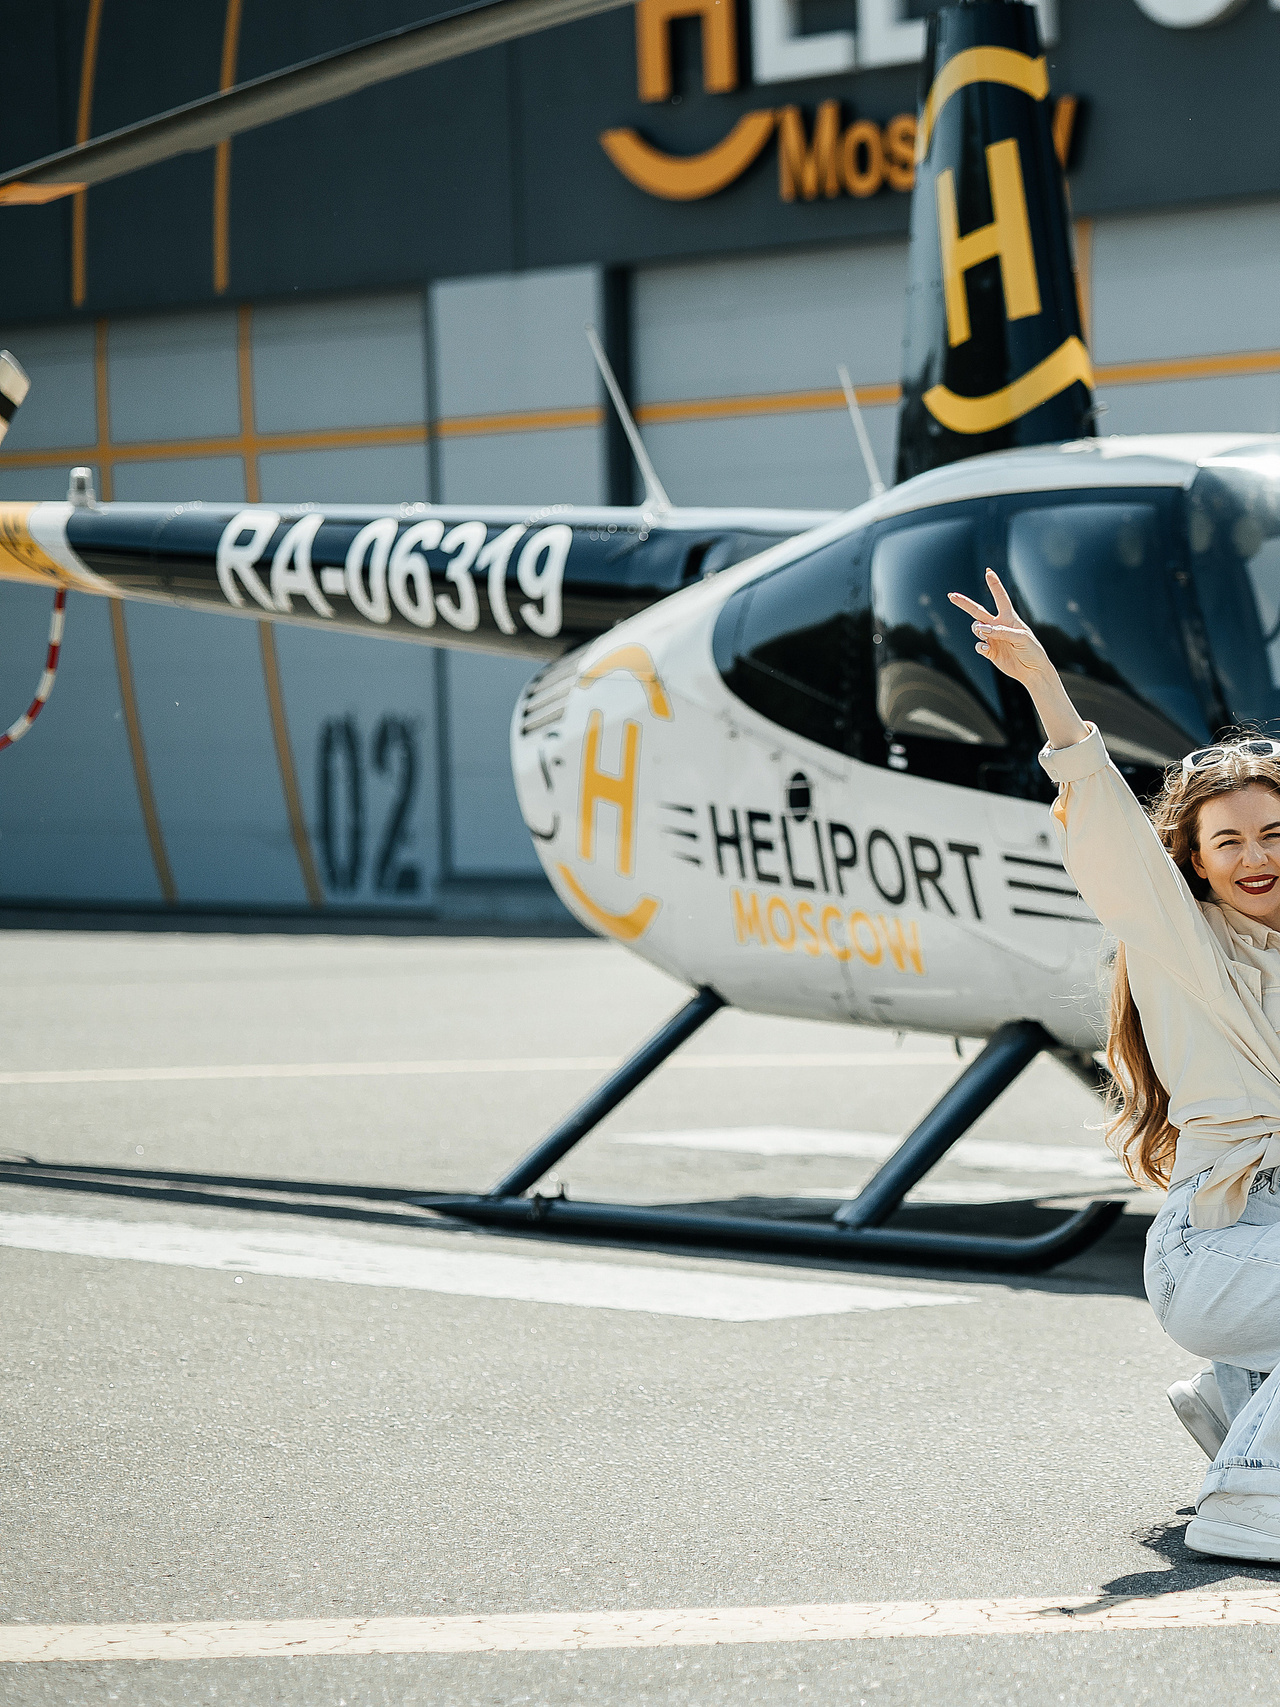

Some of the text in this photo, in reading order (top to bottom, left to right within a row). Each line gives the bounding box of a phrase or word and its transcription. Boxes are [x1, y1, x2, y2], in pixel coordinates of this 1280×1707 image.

[936, 137, 1042, 347] H
[216, 509, 573, 638] RA-06319
[316, 713, 422, 897] 02
[577, 709, 641, 877] H
[708, 803, 982, 921] HELIPORT
[731, 887, 926, 976] MOSCOW
